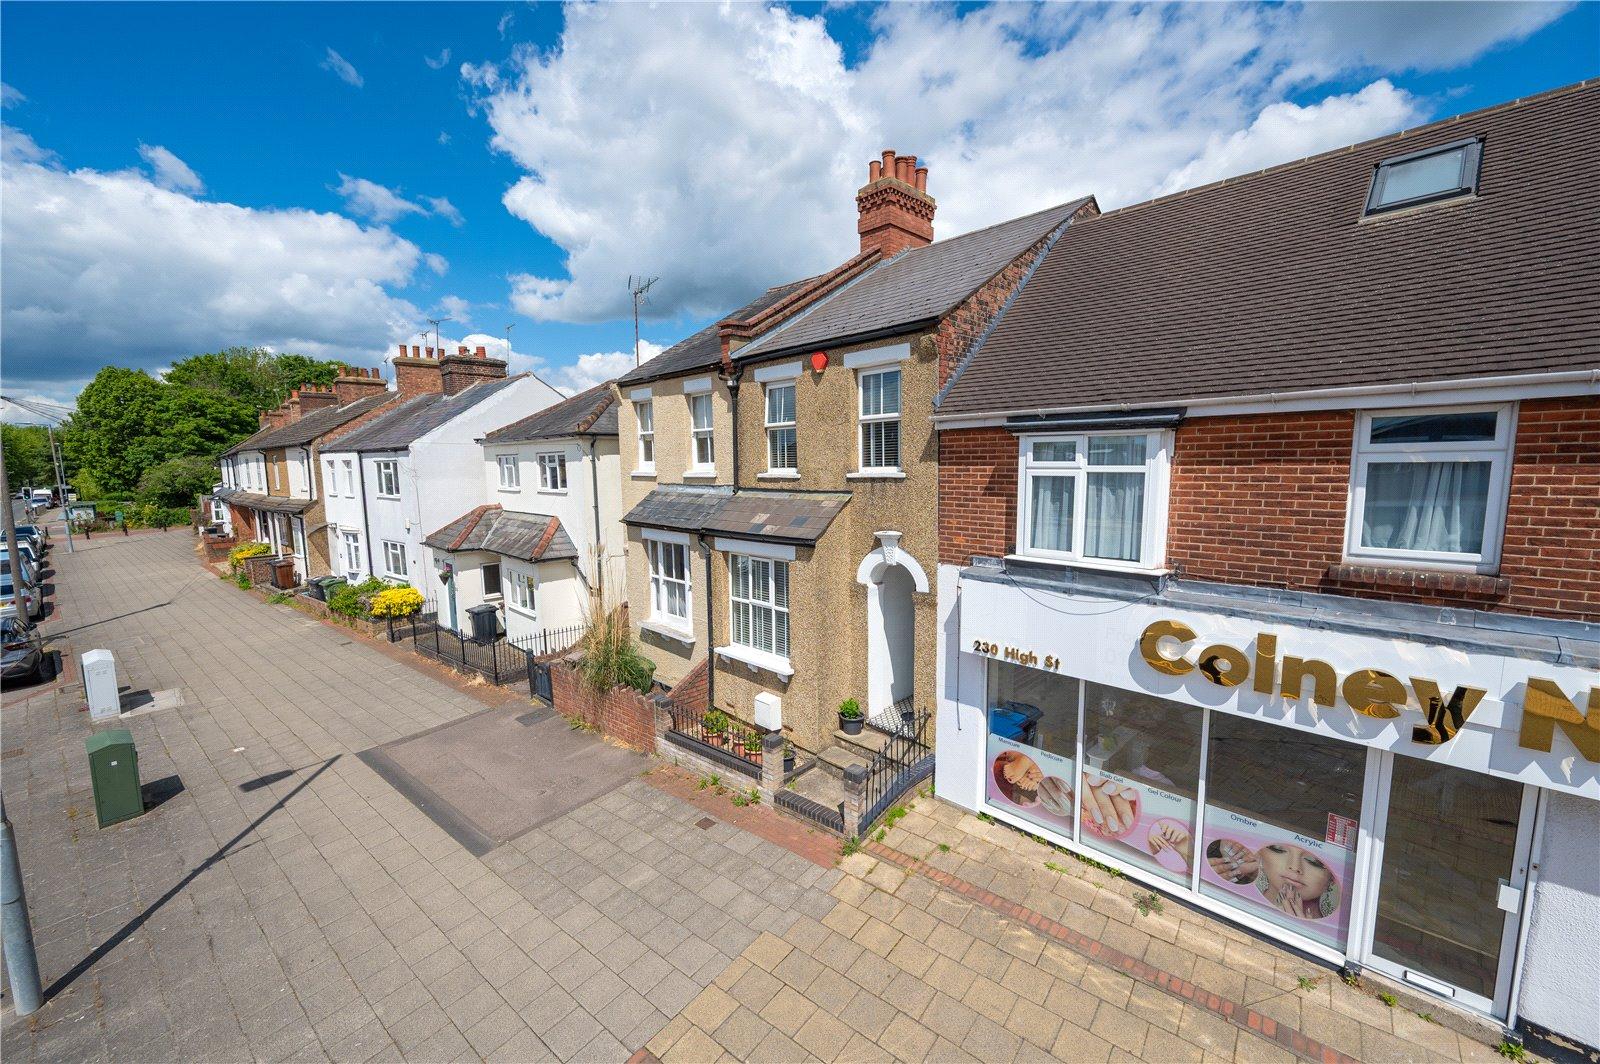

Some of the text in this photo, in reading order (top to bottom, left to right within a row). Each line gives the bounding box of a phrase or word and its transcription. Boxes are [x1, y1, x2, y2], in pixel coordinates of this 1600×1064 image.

[973, 640, 1061, 670] 230 High St
[1139, 619, 1487, 745] Colney
[998, 737, 1020, 748] Manicure
[1041, 752, 1063, 762] Pedicure
[1113, 775, 1124, 783] Gel
[1160, 791, 1182, 803] Colour
[1230, 814, 1257, 828] Ombre
[1294, 834, 1324, 850] Acrylic
